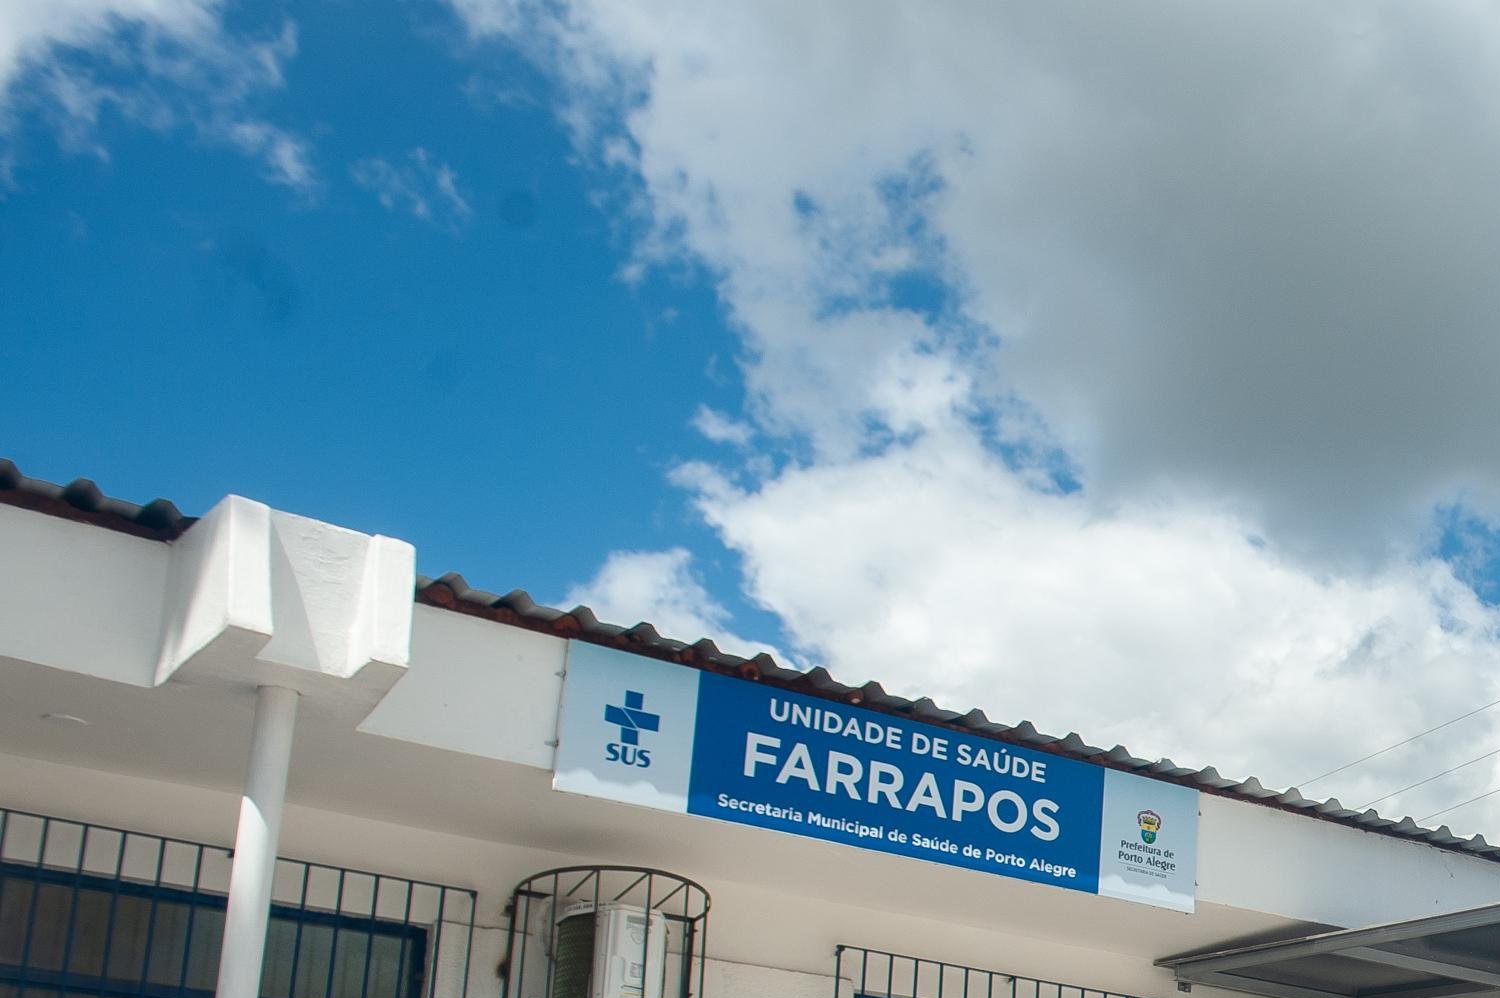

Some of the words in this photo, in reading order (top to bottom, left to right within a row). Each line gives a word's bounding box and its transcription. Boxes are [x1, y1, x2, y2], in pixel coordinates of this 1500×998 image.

[605, 742, 651, 768] SUS
[769, 698, 903, 750] UNIDADE
[911, 732, 949, 761] DE
[956, 743, 1047, 784] SAÚDE
[743, 731, 1061, 842] FARRAPOS
[717, 793, 803, 823] Secretaria
[807, 811, 884, 840] Municipal
[887, 829, 908, 844] de
[911, 833, 959, 854] Saúde
[962, 844, 982, 859] de
[985, 848, 1026, 868] Porto
[1029, 857, 1077, 878] Alegre
[1118, 850, 1143, 864] Porto
[1146, 856, 1176, 871] Alegre
[1121, 840, 1161, 856] Prefeitura
[1163, 849, 1175, 859] de
